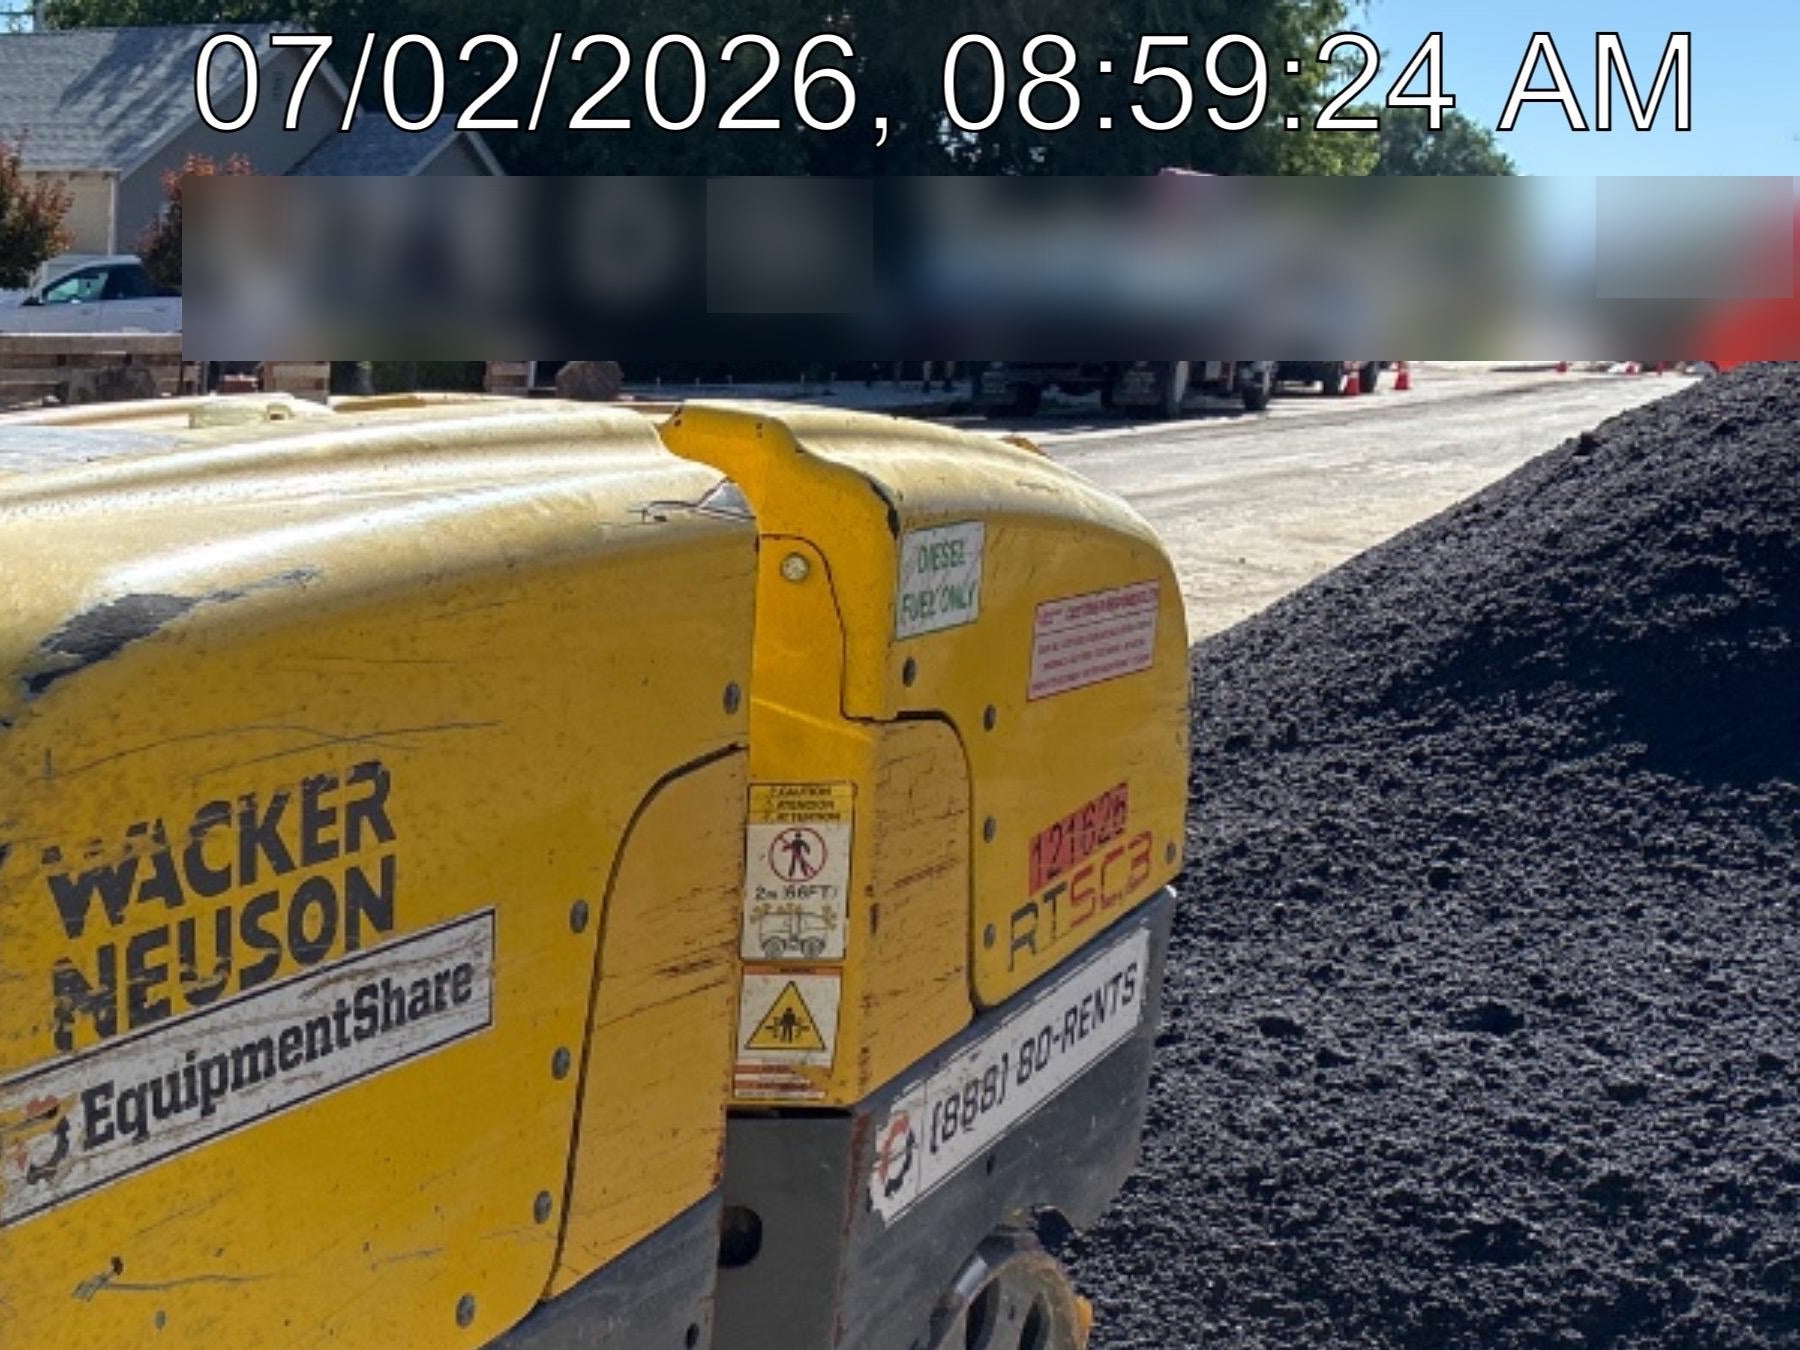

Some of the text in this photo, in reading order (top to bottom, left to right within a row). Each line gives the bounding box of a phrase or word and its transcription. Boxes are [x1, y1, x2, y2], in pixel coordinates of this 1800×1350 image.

[902, 580, 977, 622] FUEL ONLY
[917, 538, 967, 574] DIESEL
[41, 760, 397, 940] WACKER
[51, 854, 396, 1052] NEUSON
[79, 960, 475, 1152] EquipmentShare
[929, 1052, 1007, 1155] (888)
